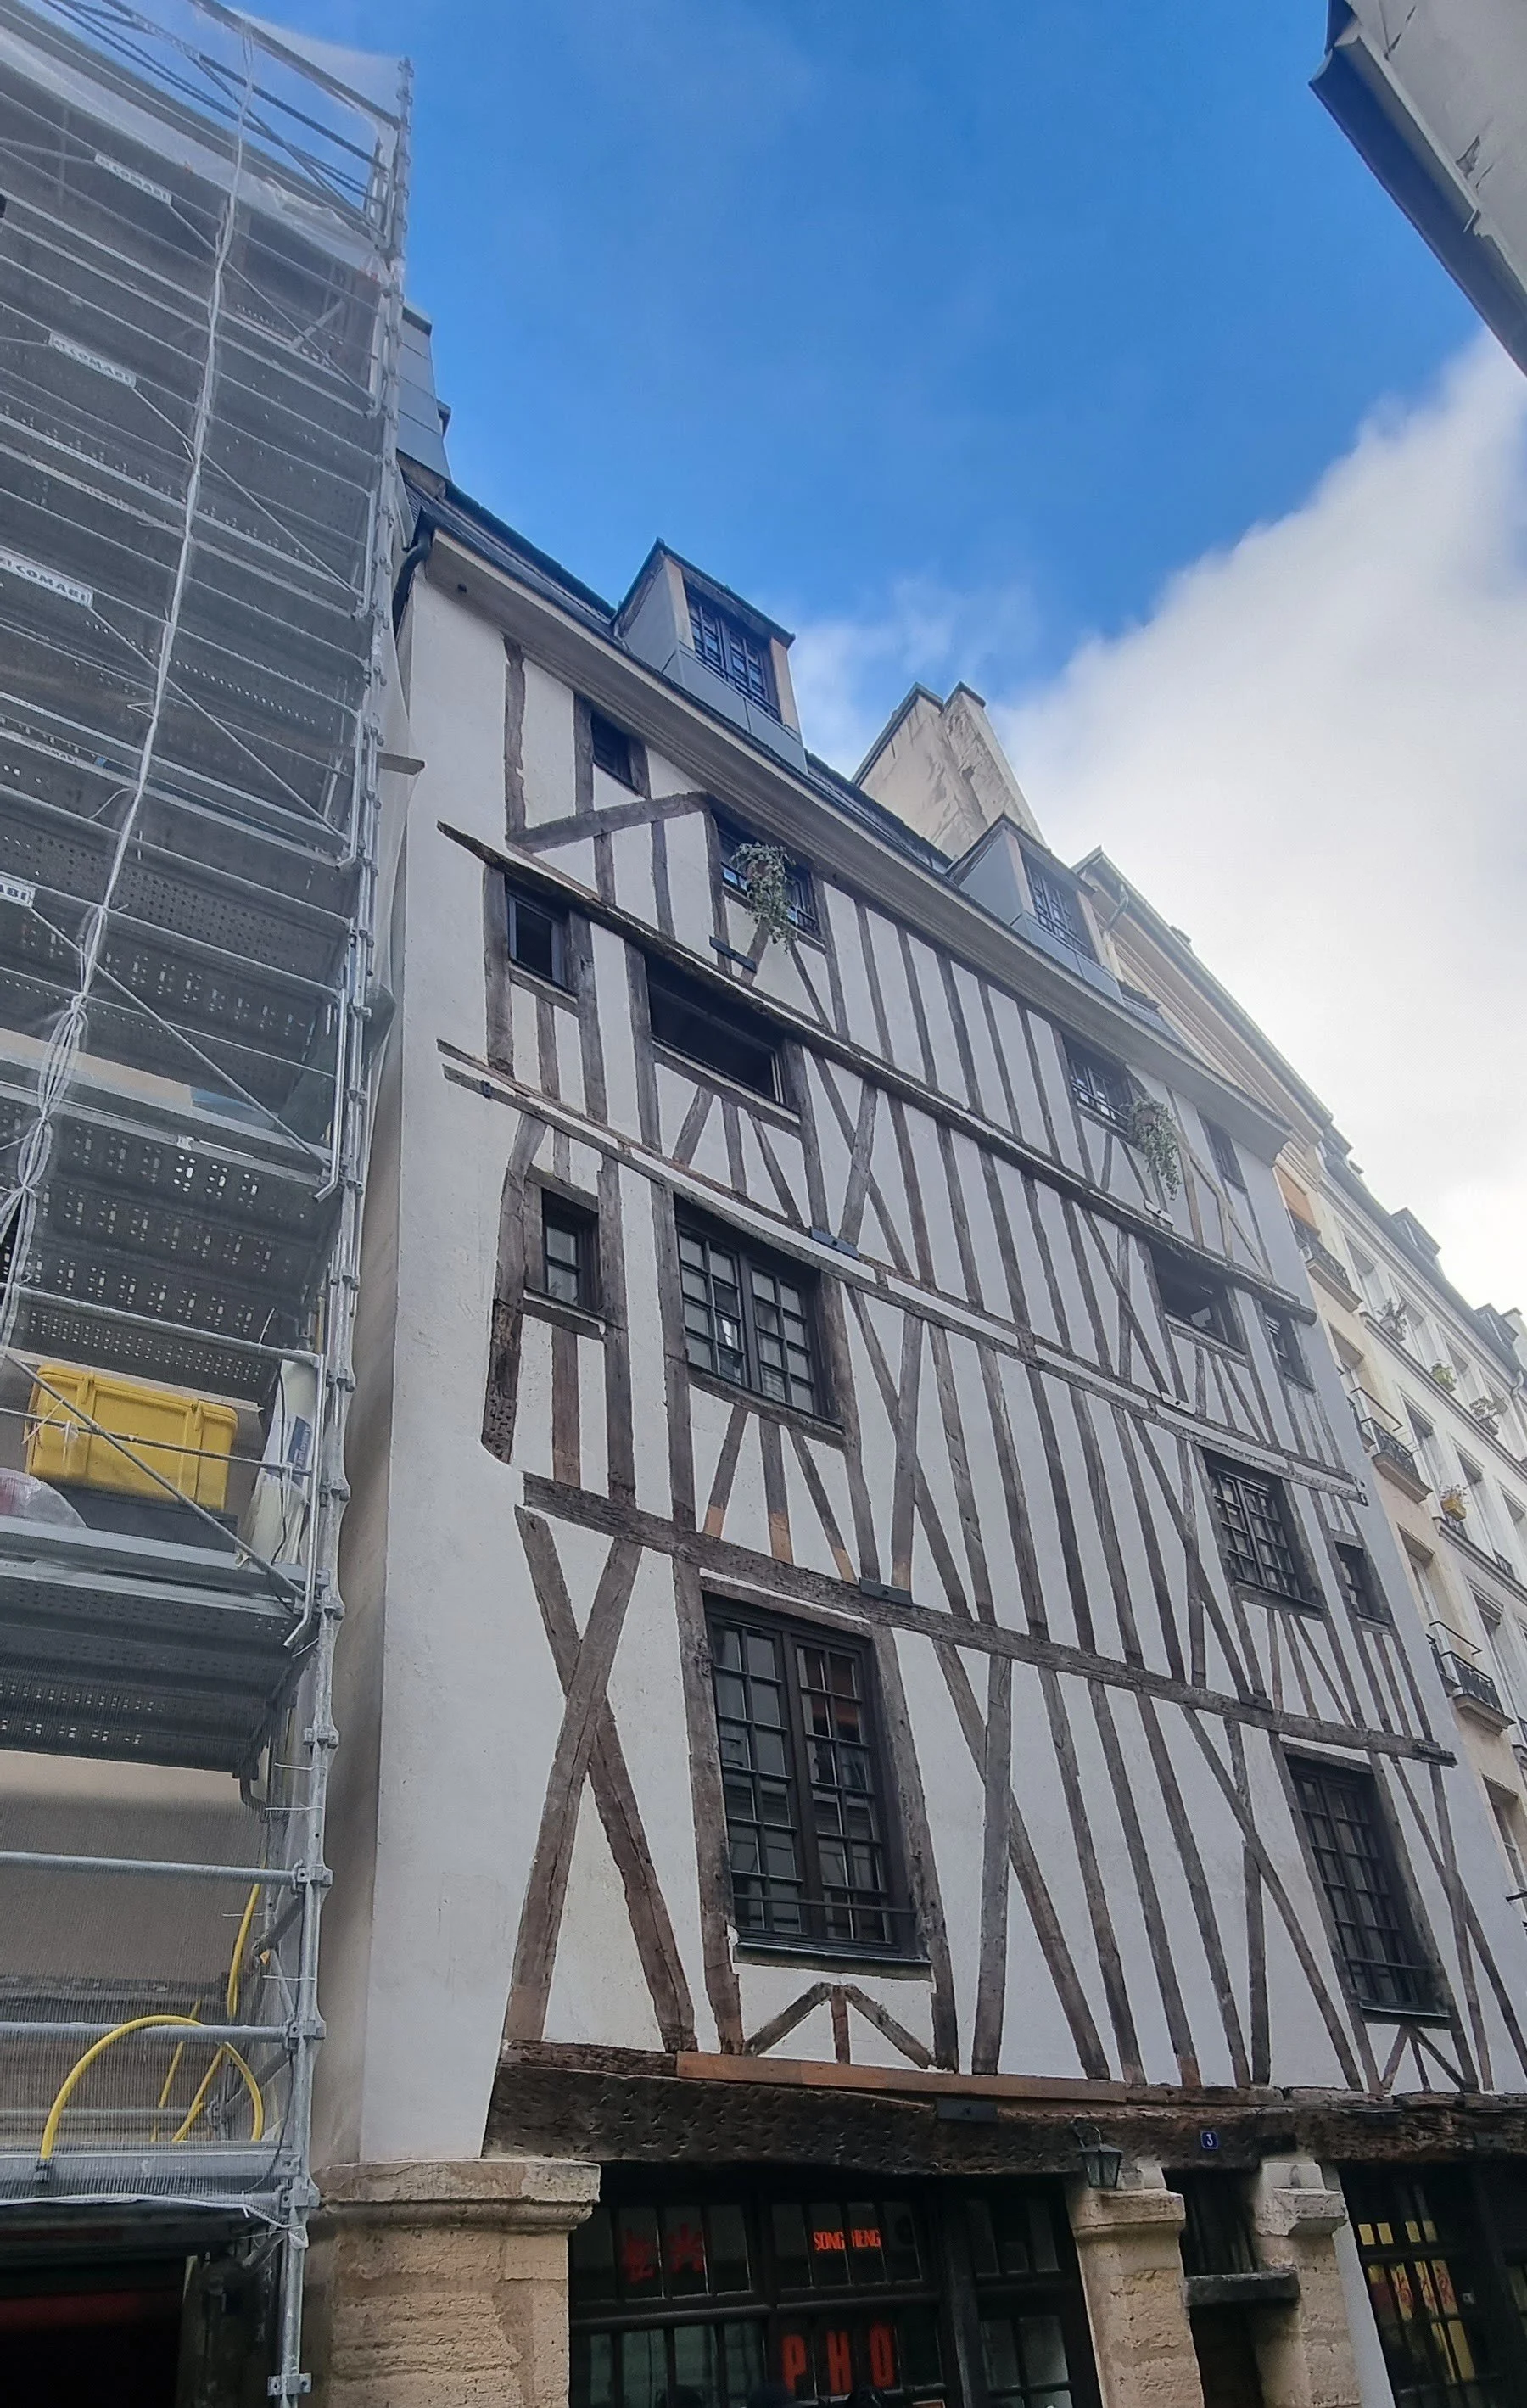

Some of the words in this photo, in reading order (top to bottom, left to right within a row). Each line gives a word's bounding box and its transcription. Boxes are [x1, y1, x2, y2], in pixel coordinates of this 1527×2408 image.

[16, 565, 86, 601] COMABI
[1206, 2133, 1213, 2146] 3
[814, 2231, 846, 2250] SONG
[851, 2229, 881, 2248] HENG
[782, 2325, 896, 2396] PHO
